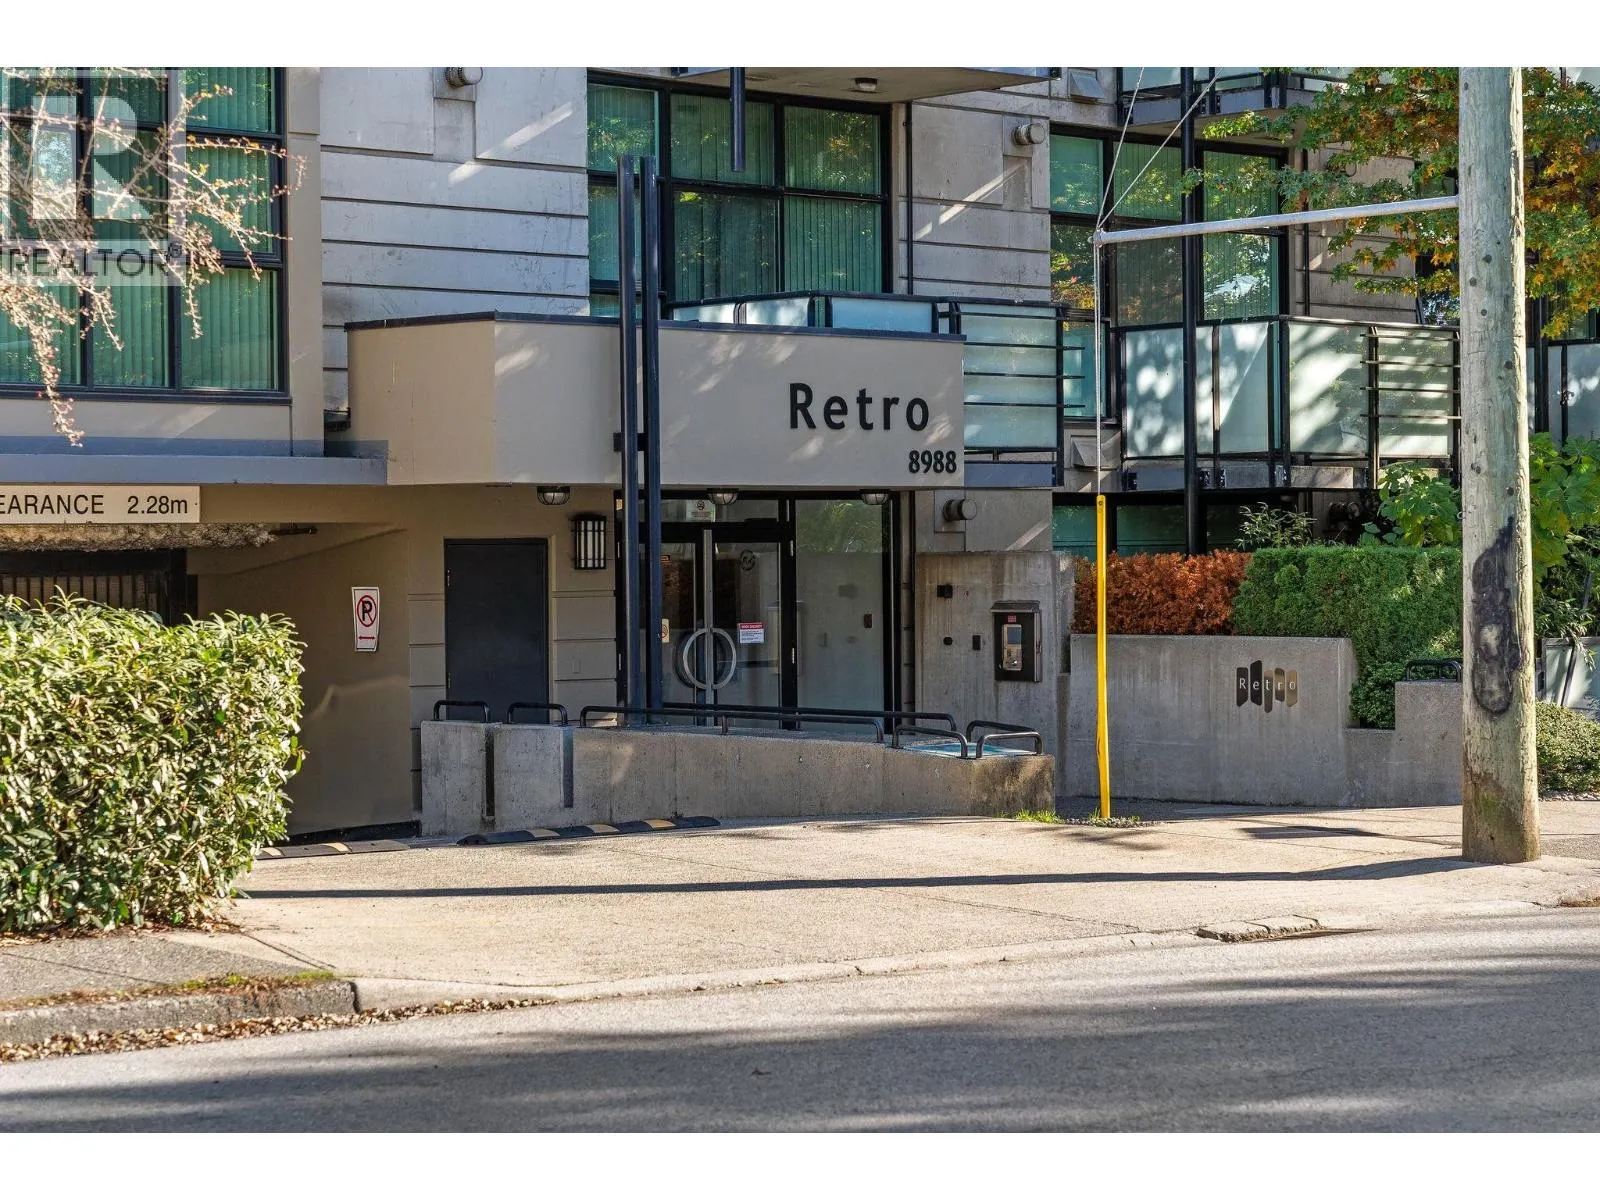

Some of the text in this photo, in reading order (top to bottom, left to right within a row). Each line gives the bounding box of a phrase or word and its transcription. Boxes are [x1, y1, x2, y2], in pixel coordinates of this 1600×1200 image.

[789, 382, 929, 431] Retro
[908, 450, 957, 474] 8988
[127, 495, 188, 514] 2.28m
[1239, 677, 1296, 691] Retro
